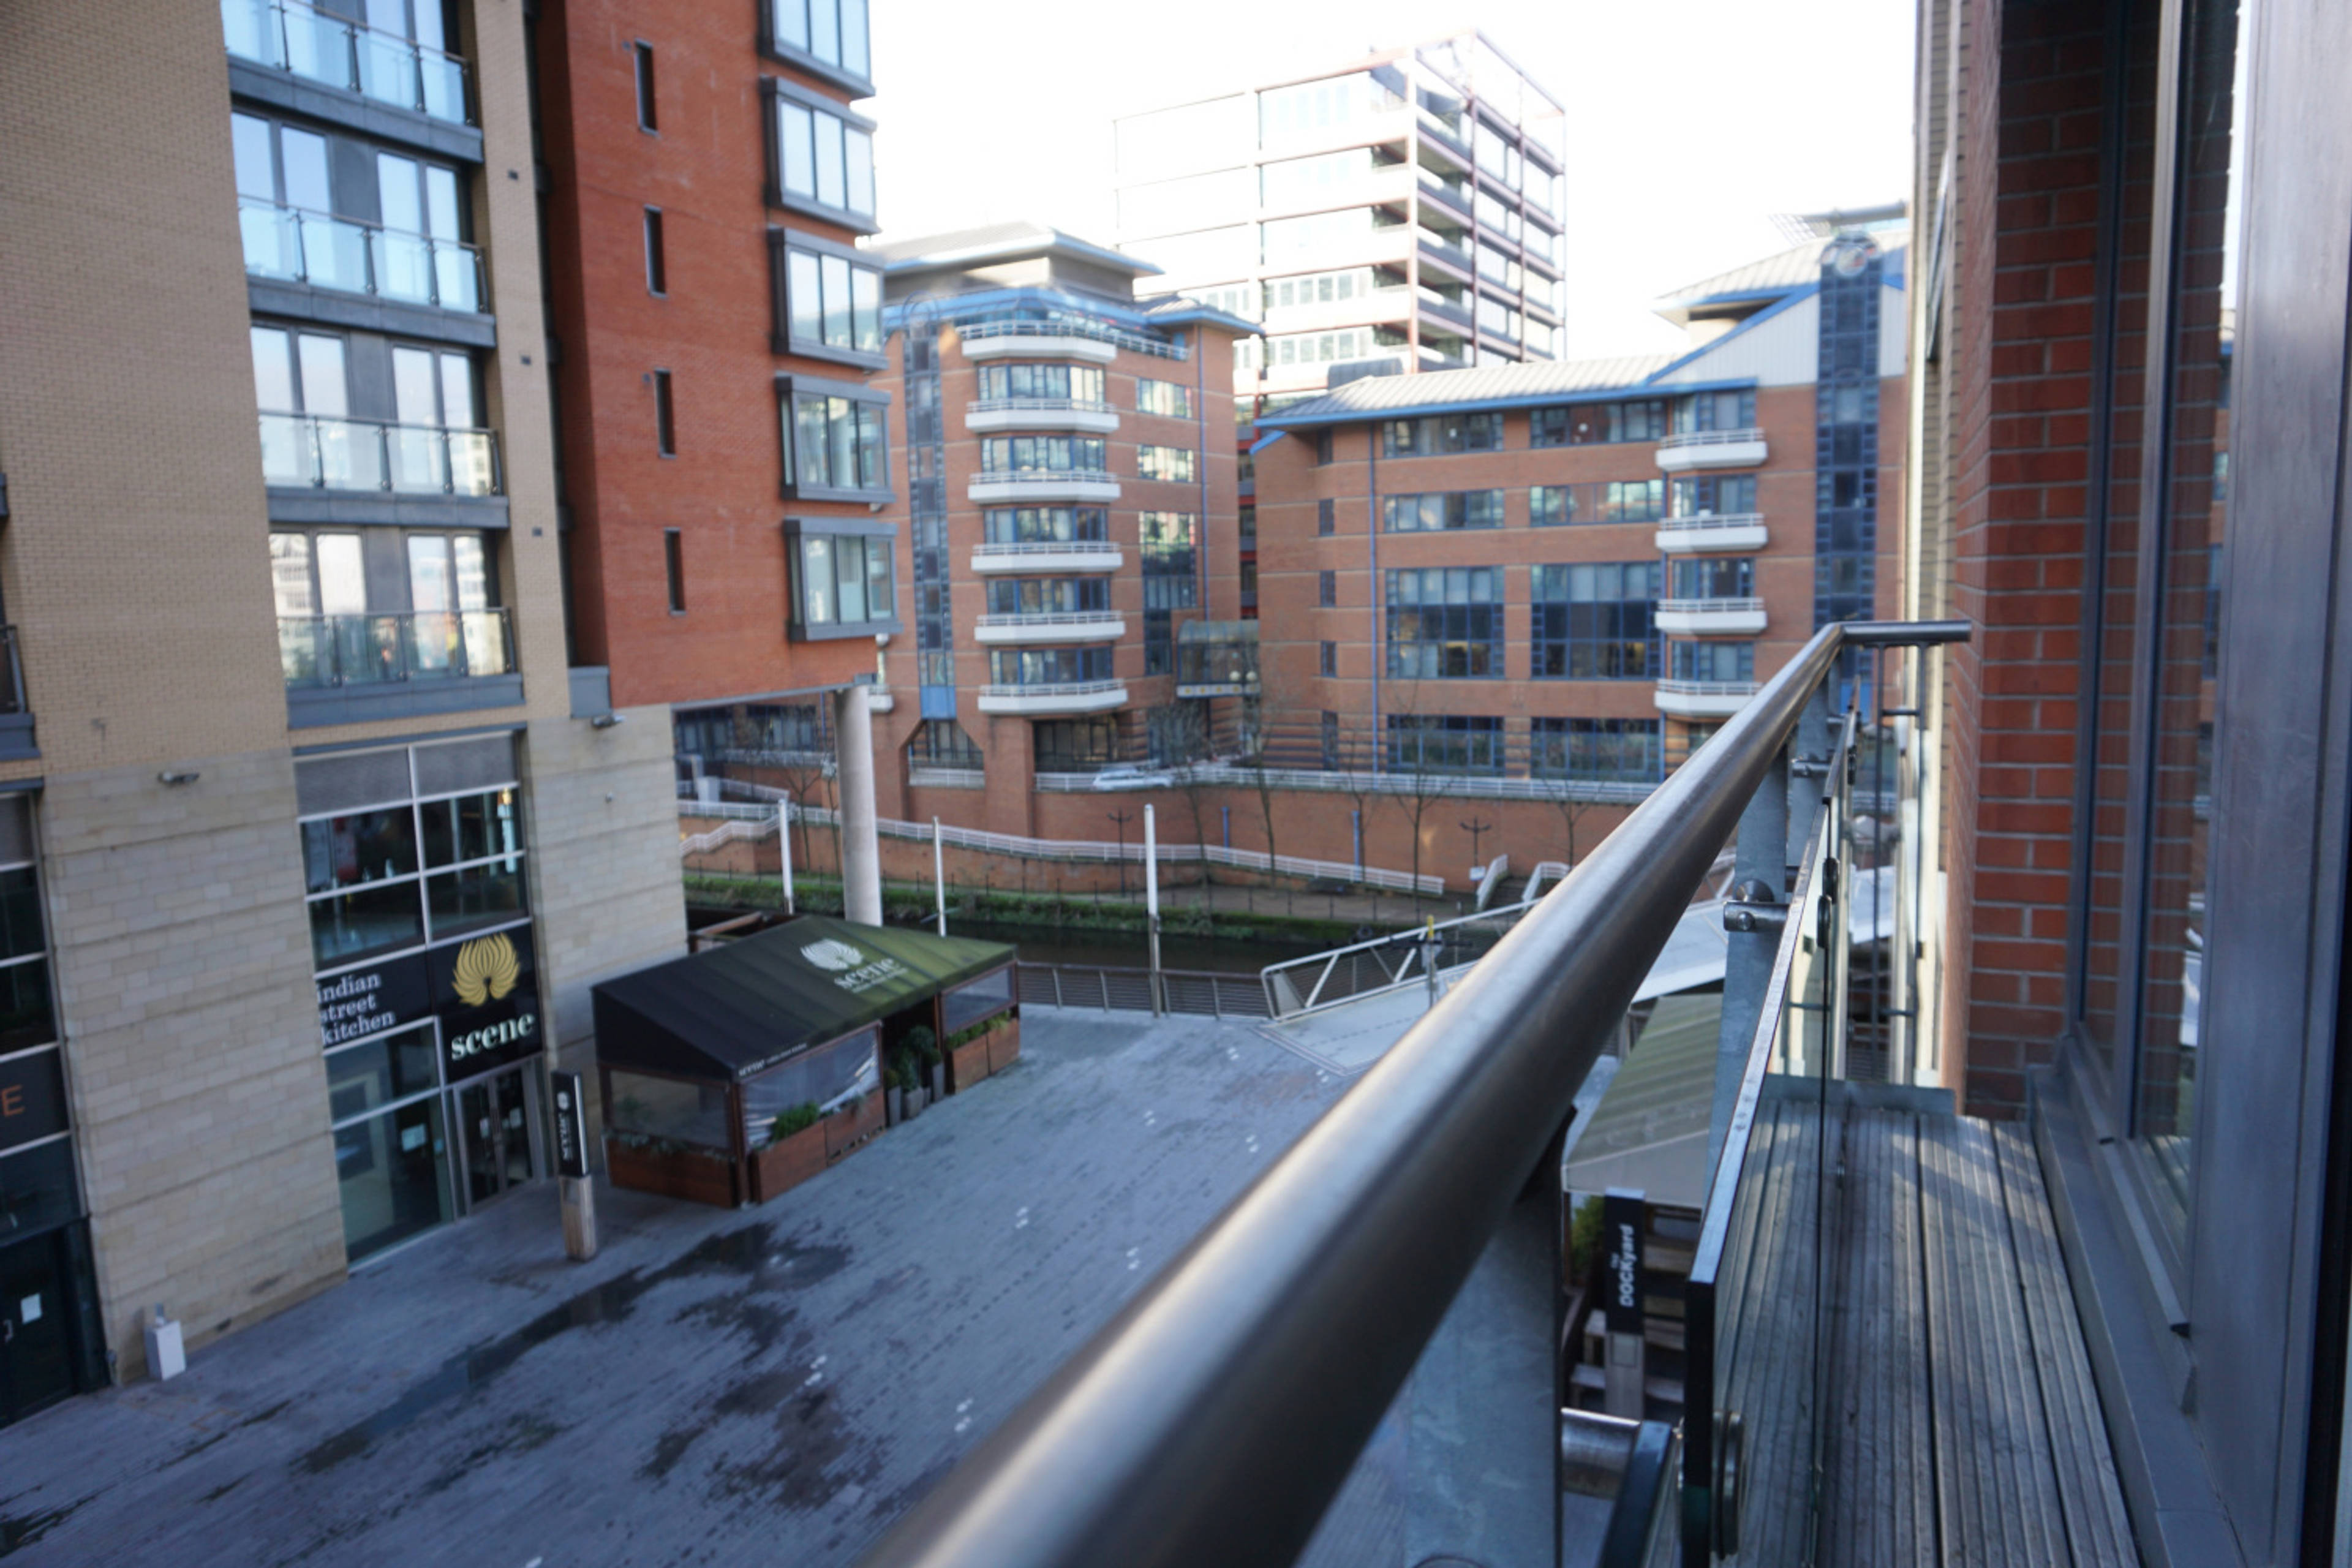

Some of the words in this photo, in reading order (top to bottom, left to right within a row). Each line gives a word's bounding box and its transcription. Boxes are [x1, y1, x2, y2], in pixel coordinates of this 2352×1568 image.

[316, 973, 382, 1004] indian
[834, 958, 897, 990] scene
[319, 992, 377, 1023] street
[321, 1011, 396, 1046] kitchen
[451, 1012, 536, 1061] scene
